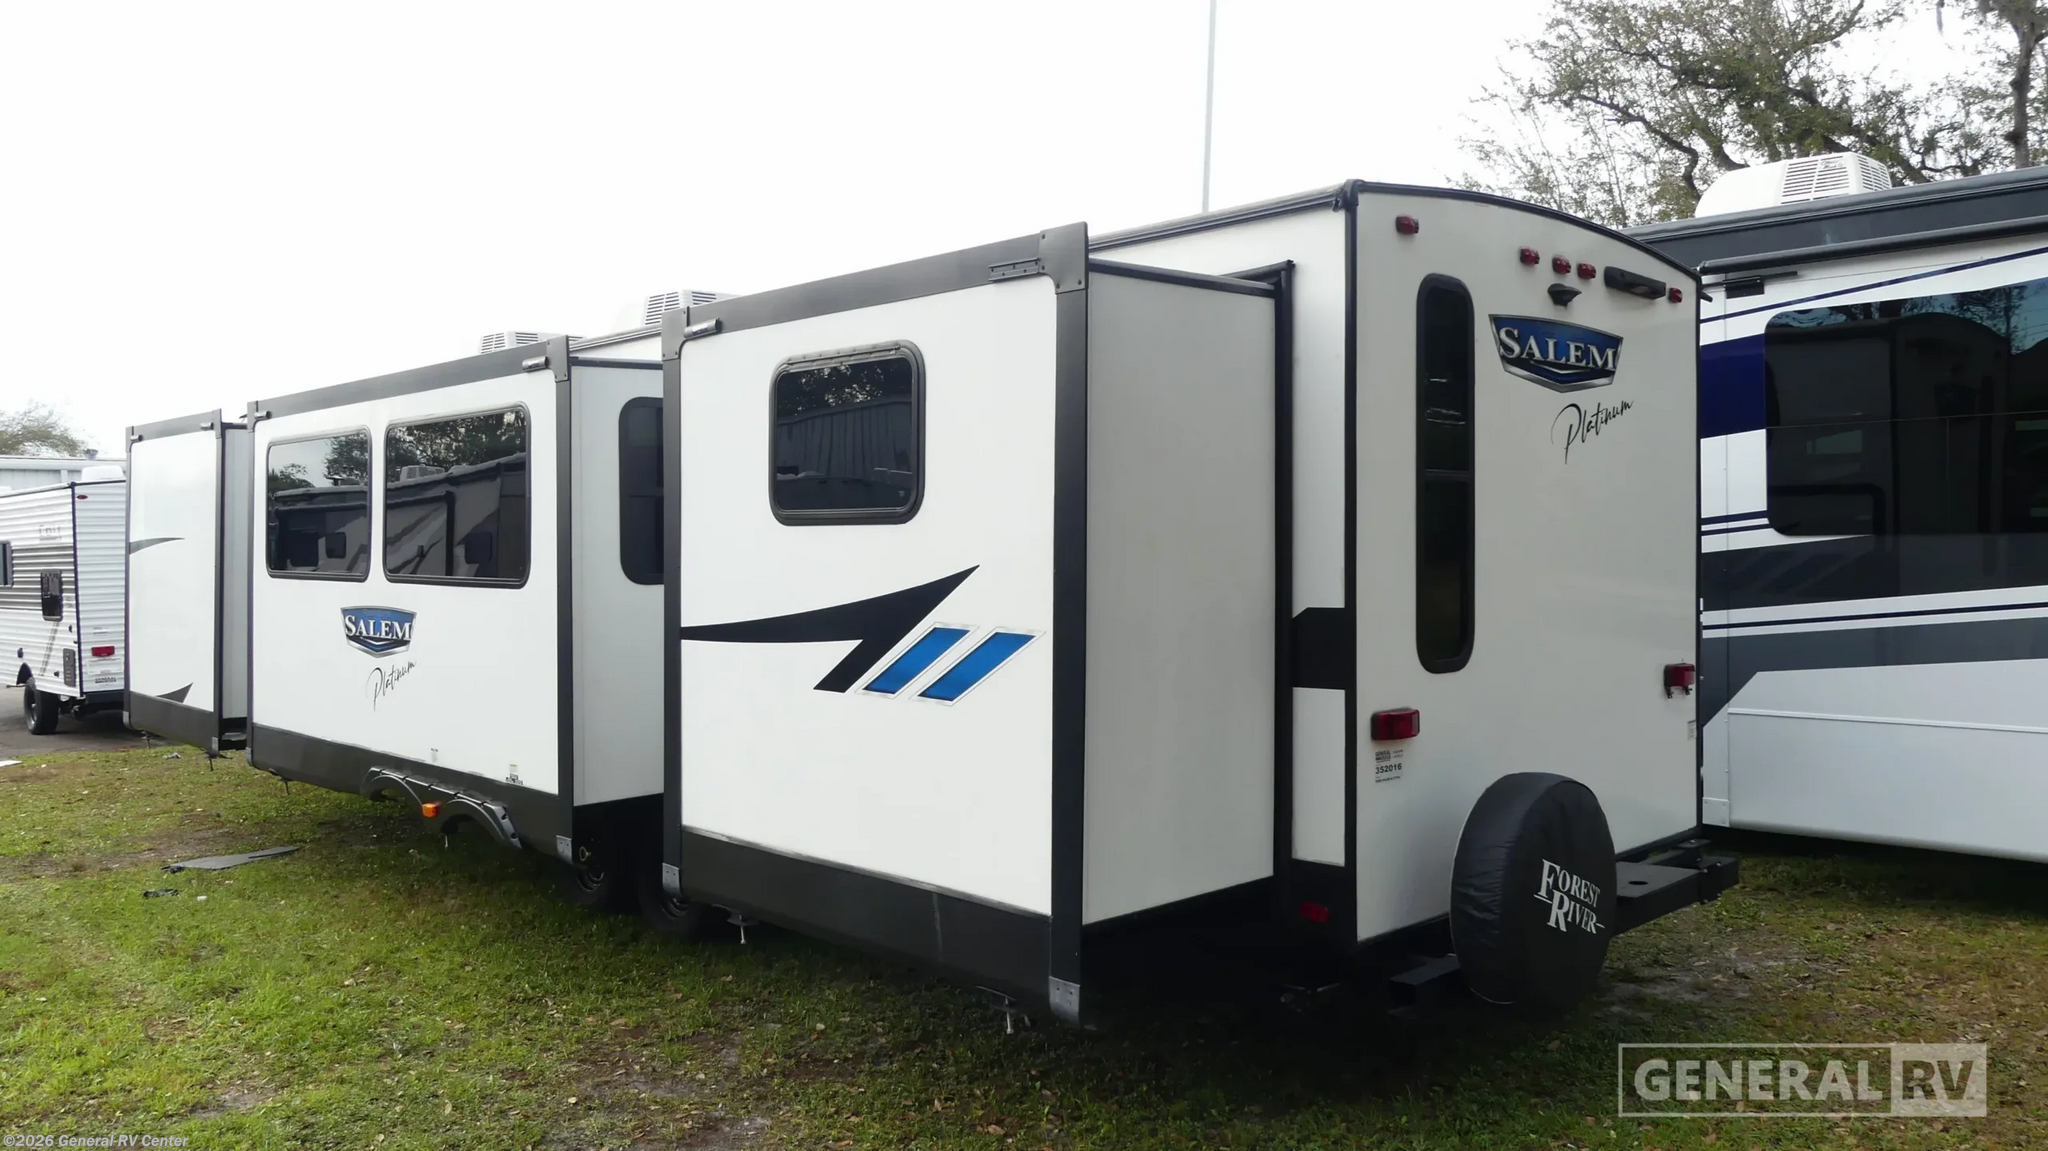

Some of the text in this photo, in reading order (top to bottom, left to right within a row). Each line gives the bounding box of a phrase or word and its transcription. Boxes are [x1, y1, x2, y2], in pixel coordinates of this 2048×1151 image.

[1499, 327, 1616, 370] SALEM
[1551, 400, 1635, 465] Platinum
[344, 614, 411, 640] SALEM
[366, 661, 417, 711] Platinum
[1375, 763, 1402, 775] 352016
[1536, 858, 1601, 908] FOREST
[1546, 889, 1598, 934] RIVER
